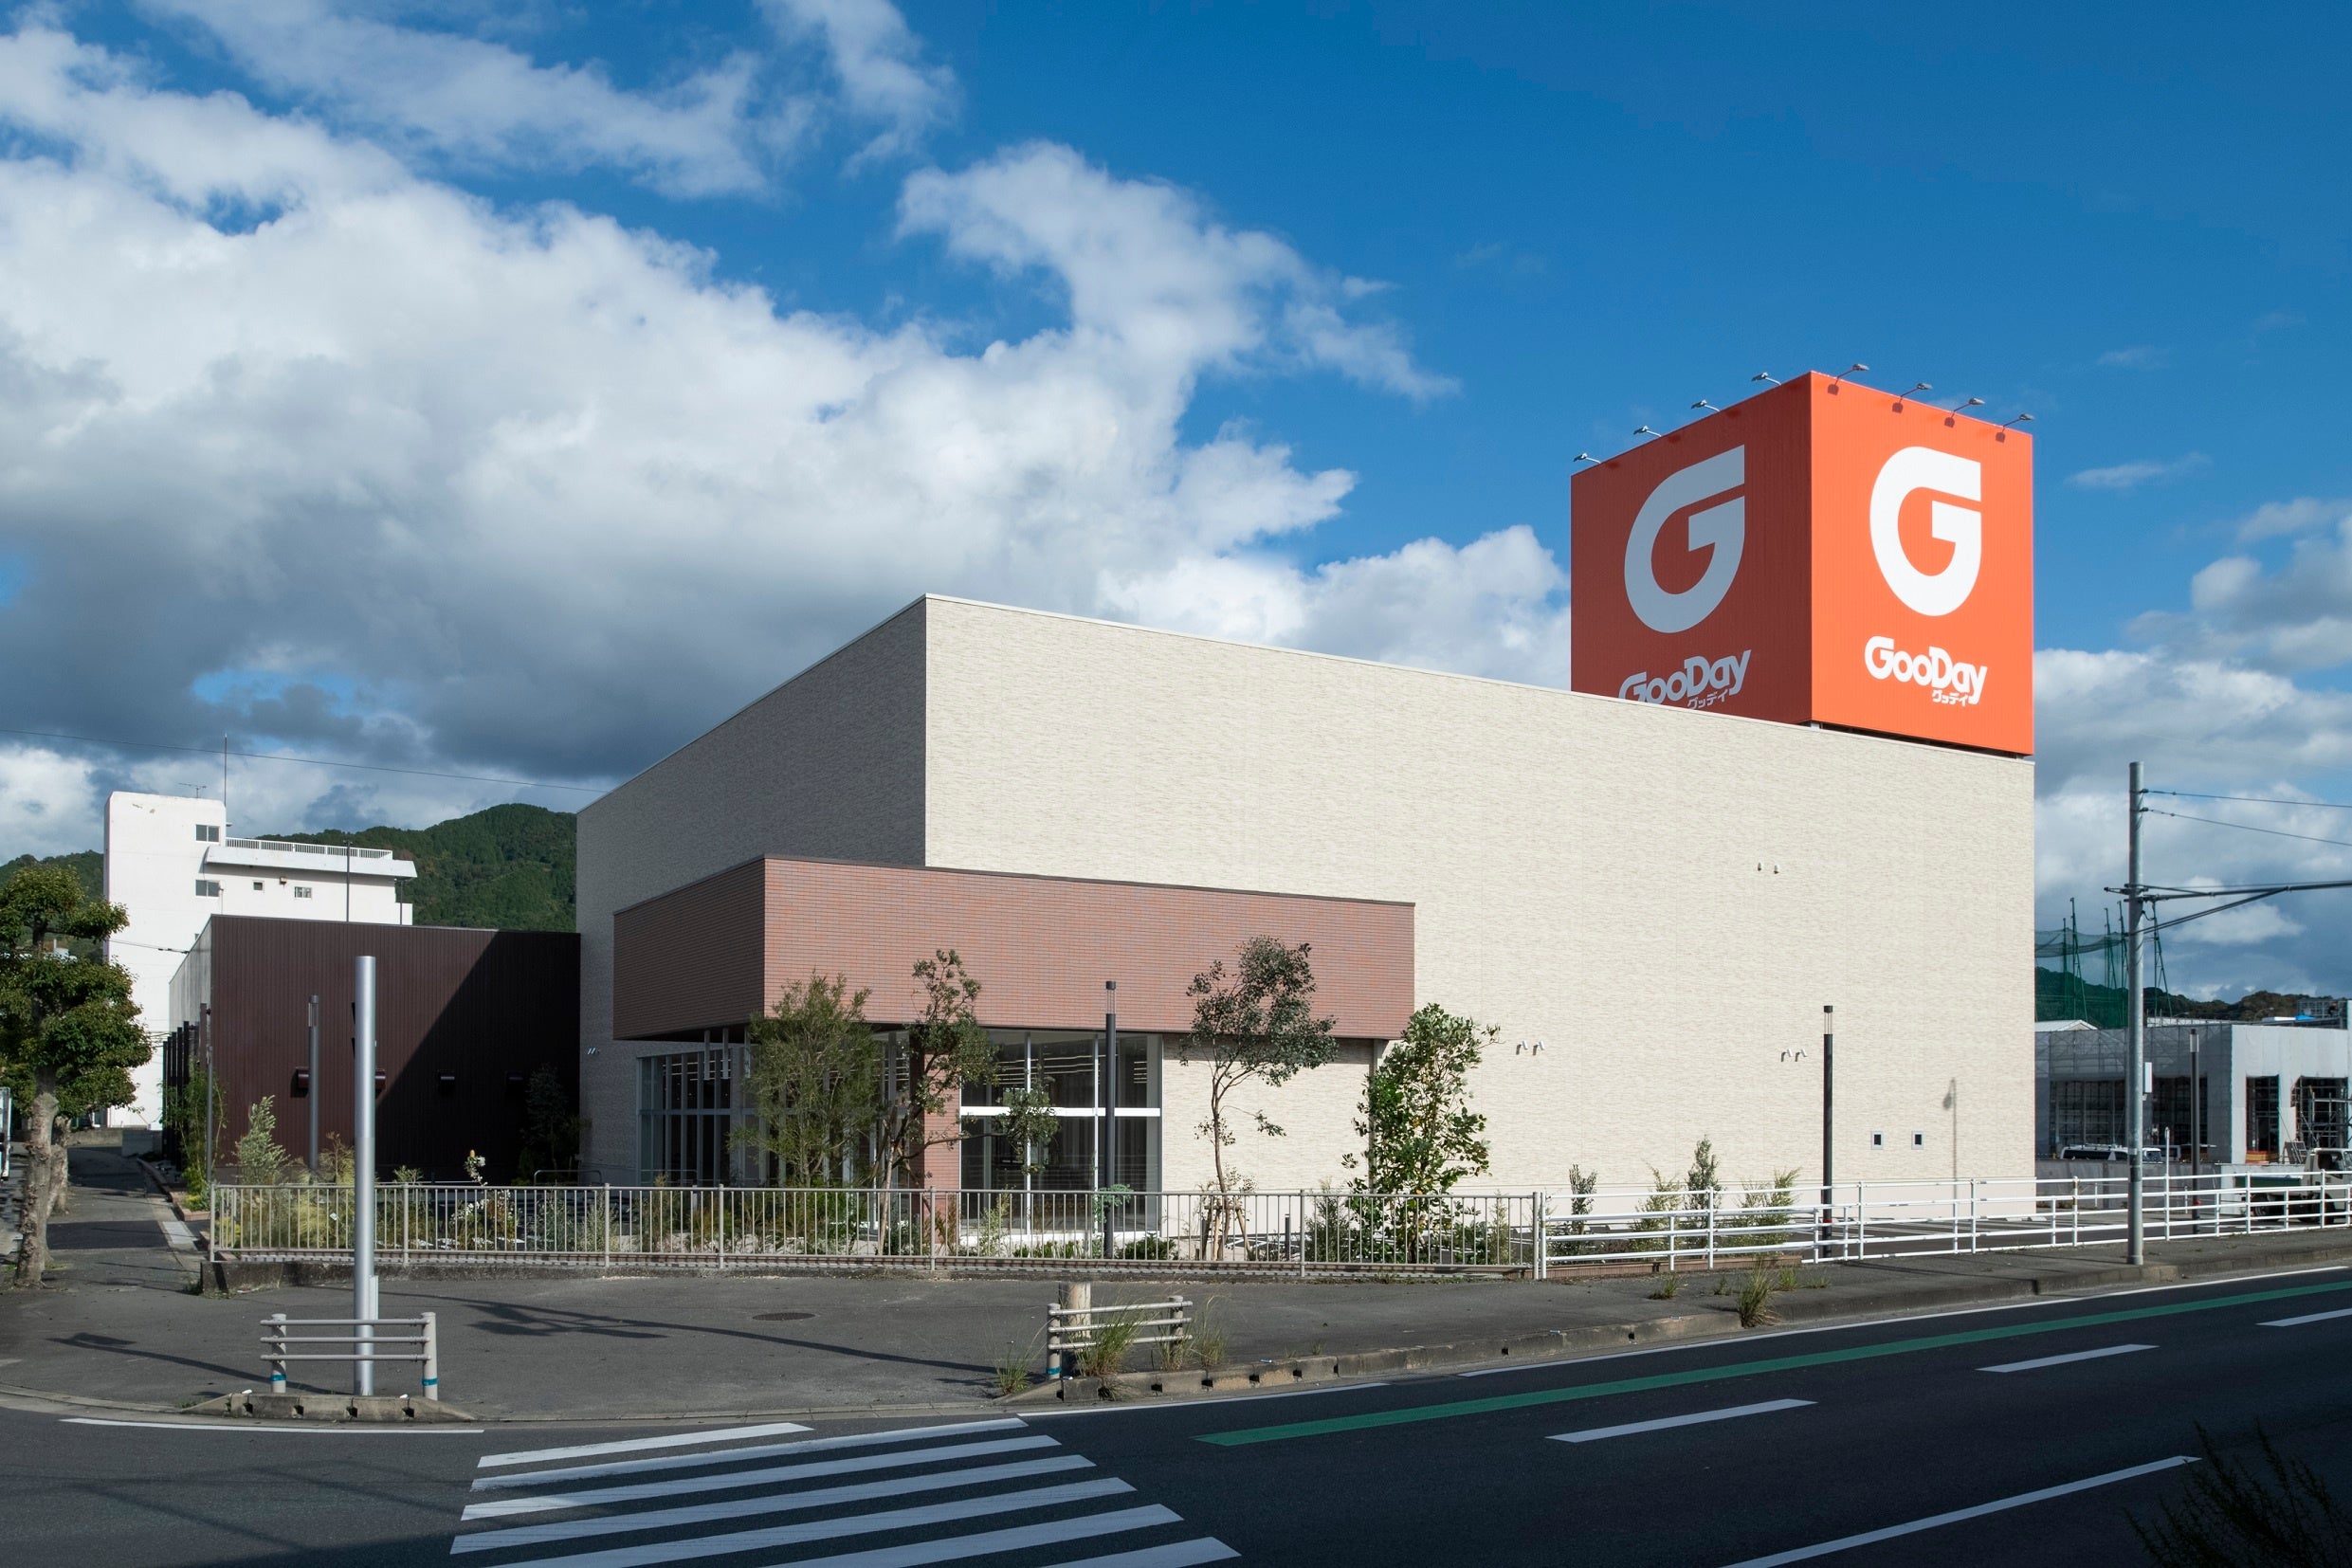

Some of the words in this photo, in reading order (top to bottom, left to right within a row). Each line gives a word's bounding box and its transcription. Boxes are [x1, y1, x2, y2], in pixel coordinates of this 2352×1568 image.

[1624, 445, 1744, 633] G
[1869, 446, 1981, 616] G
[1618, 649, 1752, 704] GooDay
[1864, 635, 1988, 704] GooDay
